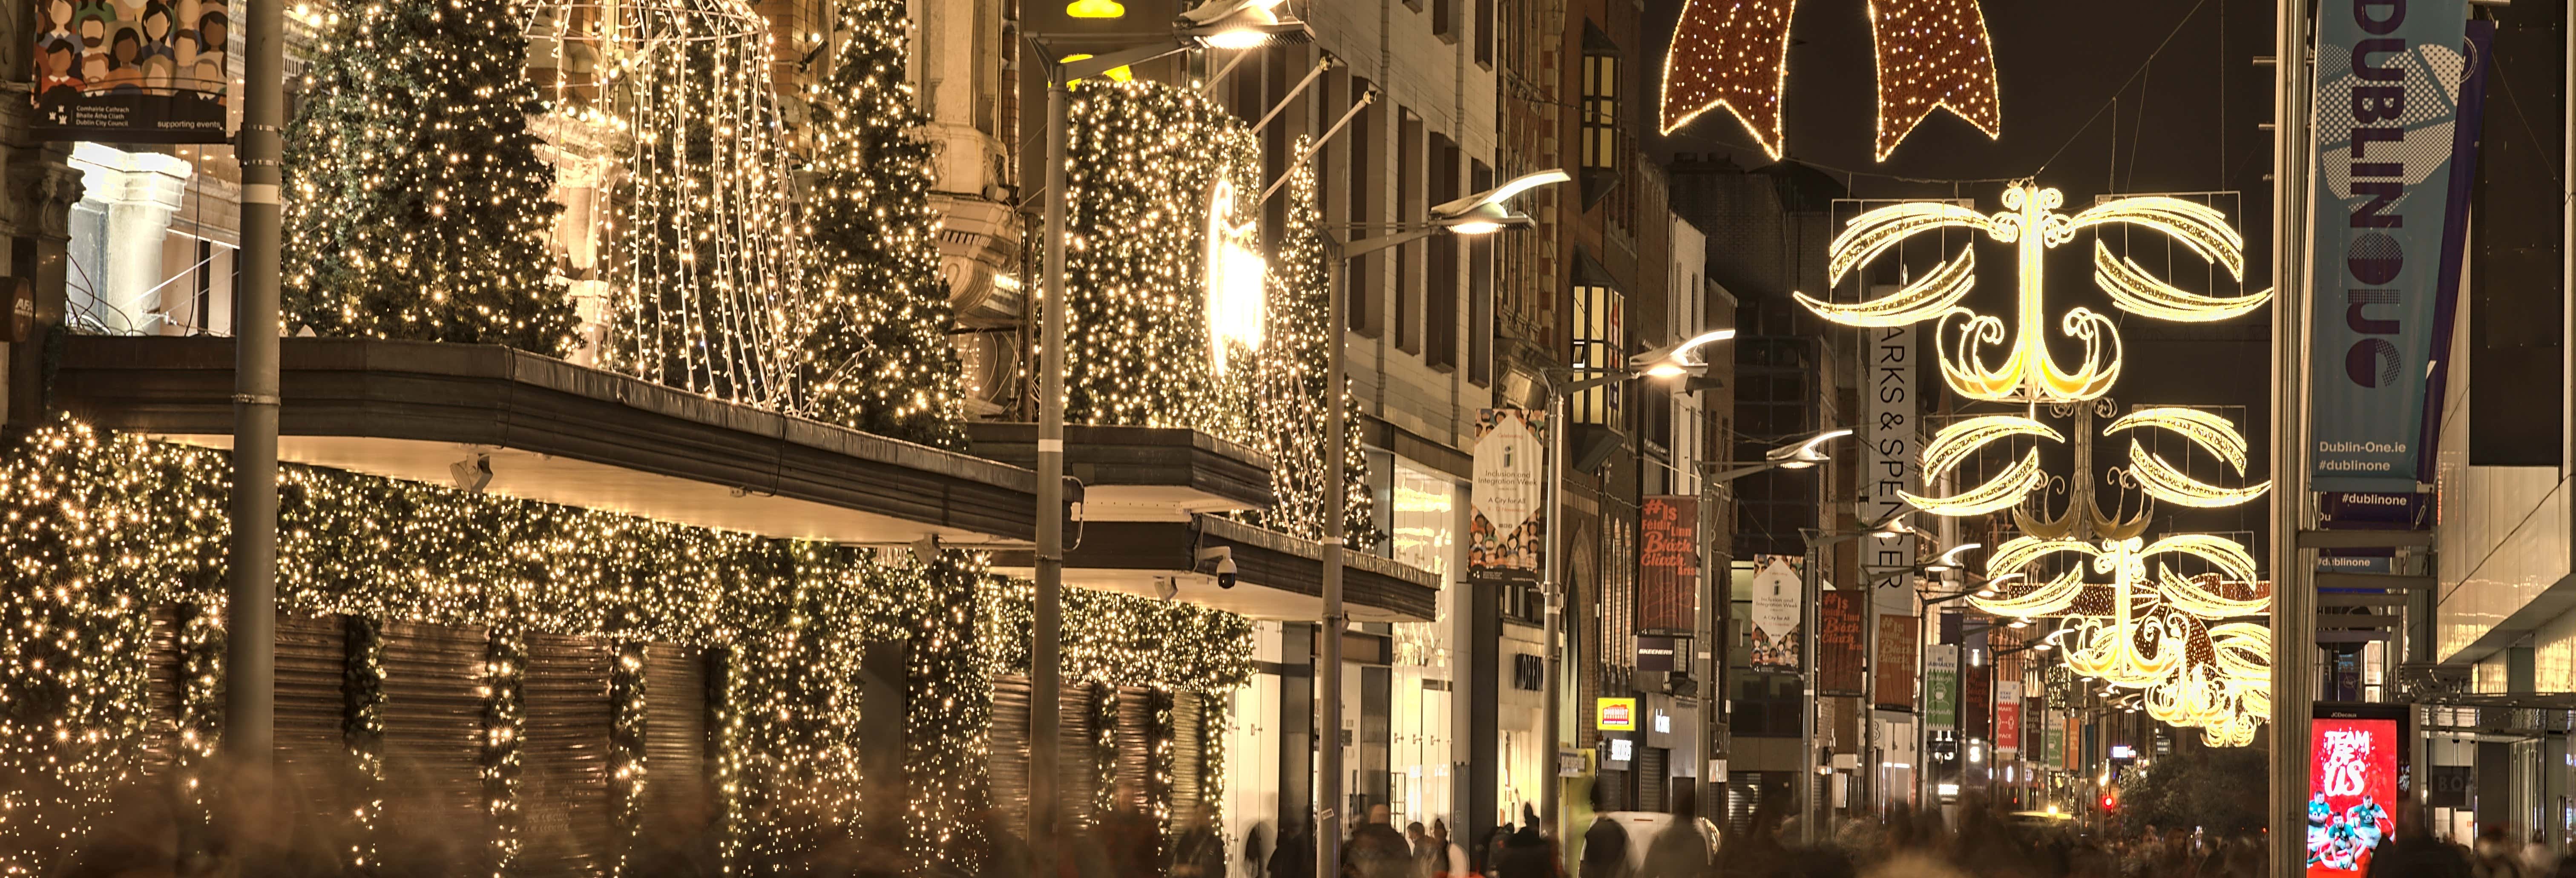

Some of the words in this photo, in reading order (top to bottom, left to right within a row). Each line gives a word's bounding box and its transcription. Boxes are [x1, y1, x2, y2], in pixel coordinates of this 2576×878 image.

[158, 121, 195, 129] supporting
[1880, 326, 1905, 403] ARKS
[1880, 411, 1904, 431] &
[2320, 442, 2406, 453] Dublin-One.ie
[2319, 460, 2390, 471] #dublinone
[1478, 476, 1515, 486] Integration
[2342, 493, 2406, 506] #dublinone
[1671, 526, 1692, 537] Linn
[1677, 565, 1696, 576] Arts
[1522, 654, 1544, 690] OFFIC
[2324, 730, 2370, 755] TEAM
[2330, 747, 2355, 767] OF
[2323, 758, 2366, 797] US
